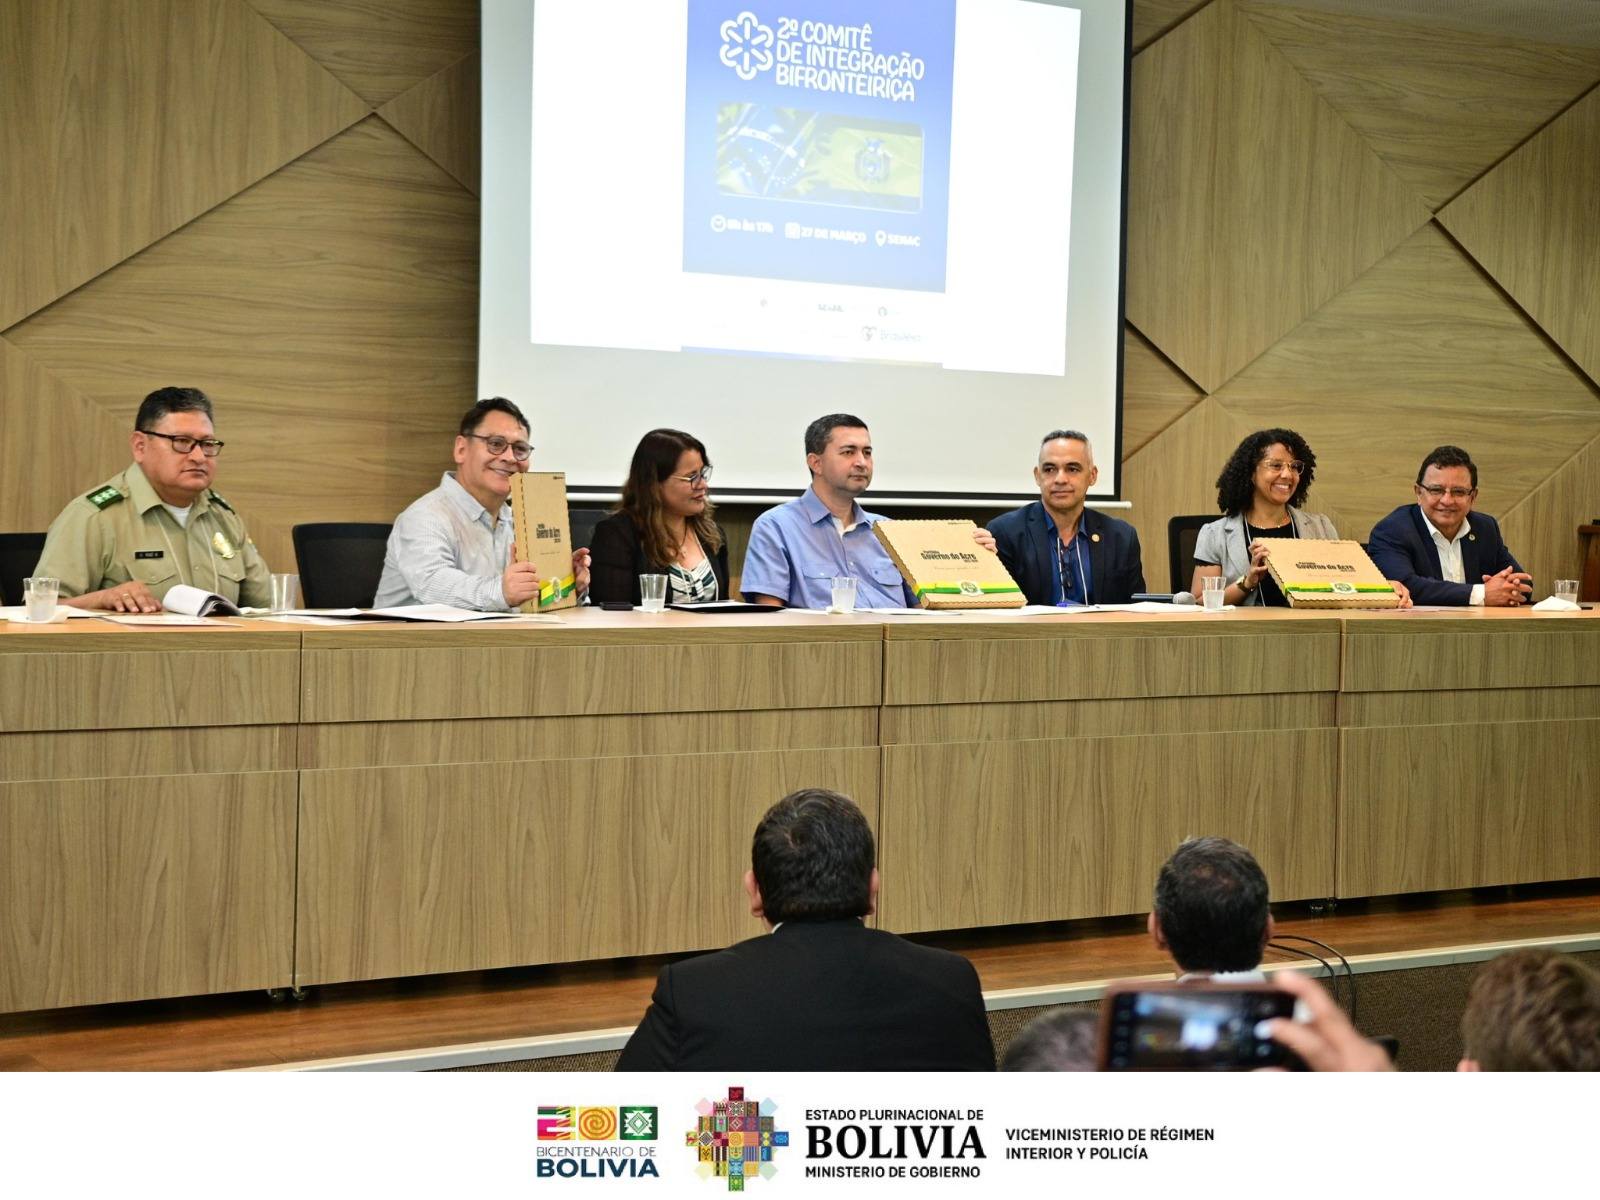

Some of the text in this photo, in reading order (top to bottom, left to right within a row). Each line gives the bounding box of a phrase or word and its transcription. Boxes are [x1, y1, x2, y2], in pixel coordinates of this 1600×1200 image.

[800, 20, 873, 51] COMITÊ
[776, 39, 925, 80] DE INTEGRAÇÃO
[775, 62, 915, 102] BIFRONTEIRIÇA
[920, 552, 950, 560] Governo
